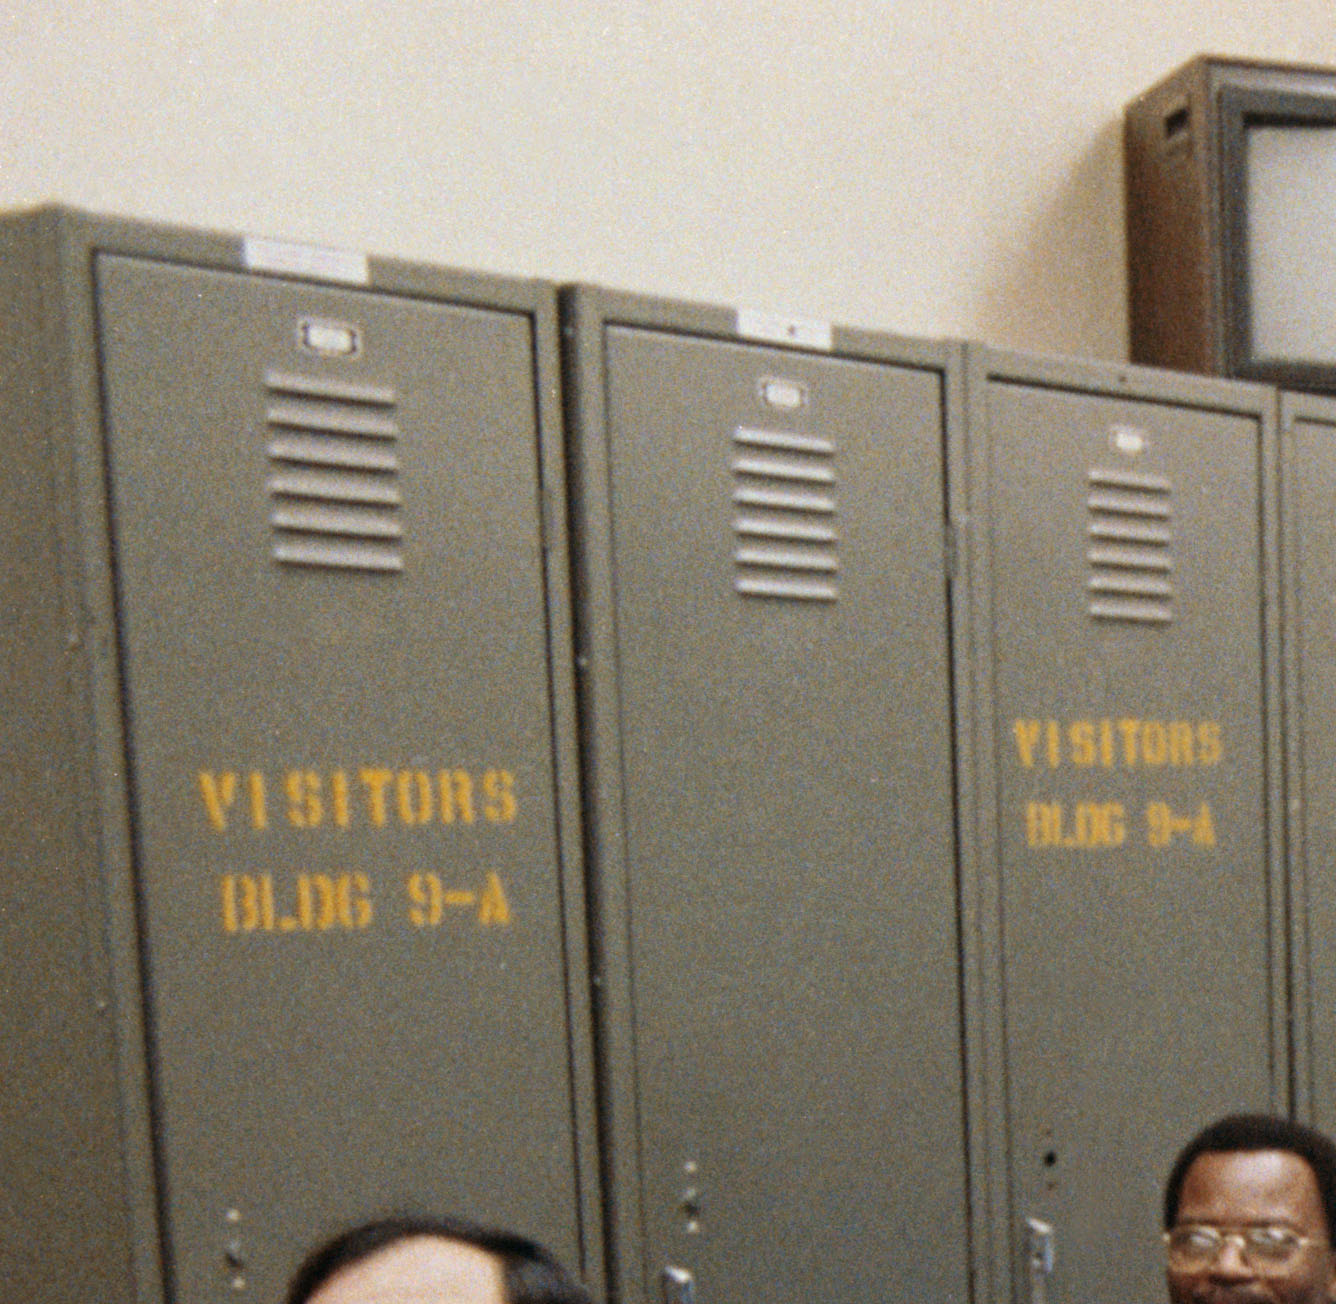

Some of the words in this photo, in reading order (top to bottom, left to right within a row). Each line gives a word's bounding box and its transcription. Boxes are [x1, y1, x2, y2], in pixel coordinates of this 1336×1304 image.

[1014, 718, 1222, 768] VISITORS
[200, 769, 517, 830] VISITORS
[1027, 801, 1125, 848] BLDG
[1147, 801, 1215, 847] 9-A
[221, 873, 372, 932] BLDG
[408, 870, 511, 927] 9-A
